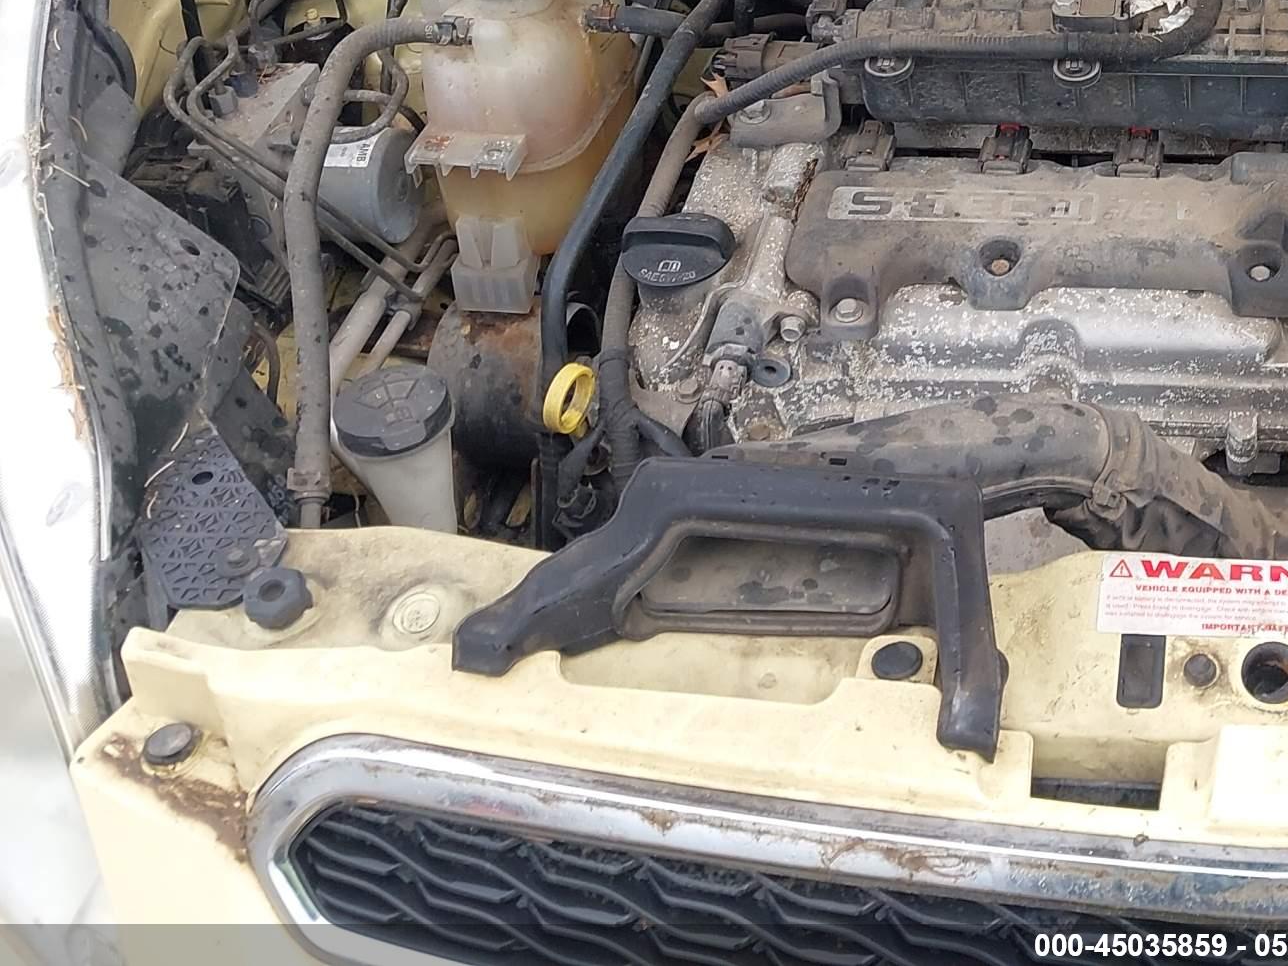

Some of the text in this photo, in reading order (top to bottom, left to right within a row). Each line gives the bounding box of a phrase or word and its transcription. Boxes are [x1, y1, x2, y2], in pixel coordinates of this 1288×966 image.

[1136, 585, 1179, 593] VEHICLE
[1182, 586, 1232, 594] EQUIPPED
[1235, 587, 1261, 595] WITH
[1201, 623, 1261, 633] IMPORTANT
